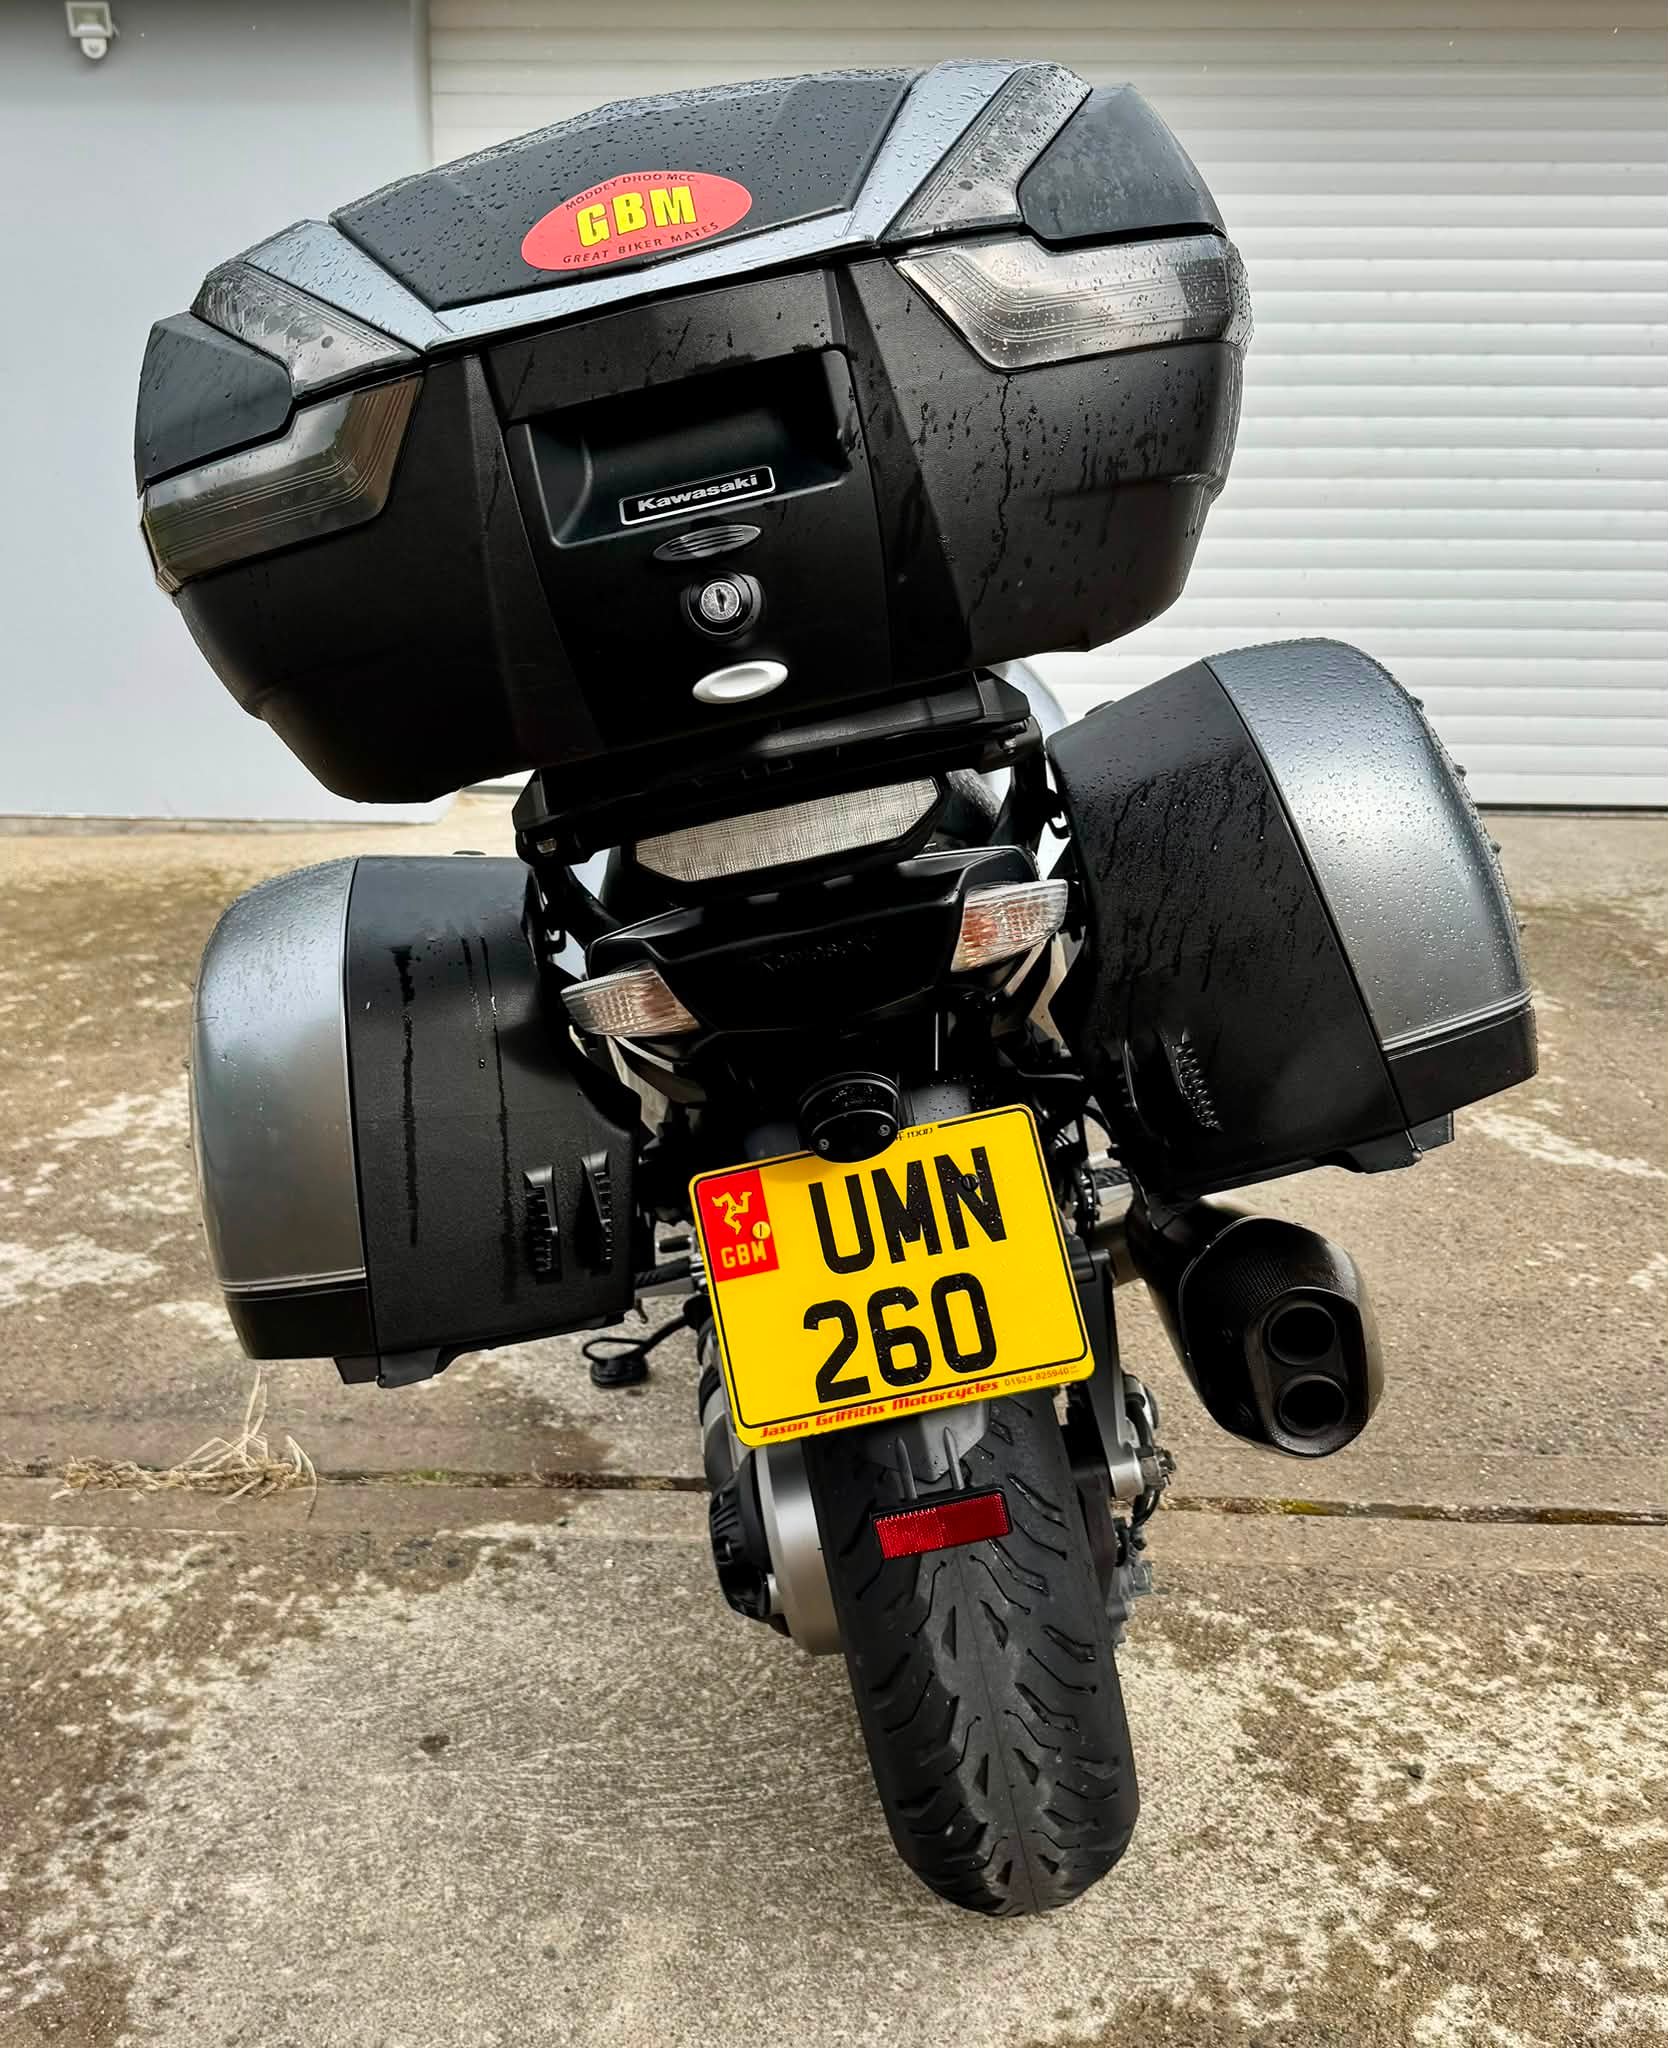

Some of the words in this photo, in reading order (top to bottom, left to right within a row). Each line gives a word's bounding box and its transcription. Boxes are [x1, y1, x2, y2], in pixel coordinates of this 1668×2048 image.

[565, 180, 617, 211] MODDEY
[666, 173, 695, 182] MCC
[575, 185, 697, 248] GBM
[562, 250, 609, 264] GREAT
[618, 239, 663, 254] BIKER
[670, 222, 719, 244] MATES
[637, 475, 758, 512] Kawasaki
[808, 1146, 1007, 1275] UMN
[720, 1241, 767, 1270] GBM
[803, 1272, 997, 1403] 260
[760, 1420, 809, 1439] Jason
[815, 1404, 886, 1427] Griffiths
[892, 1379, 999, 1411] Motorcycles
